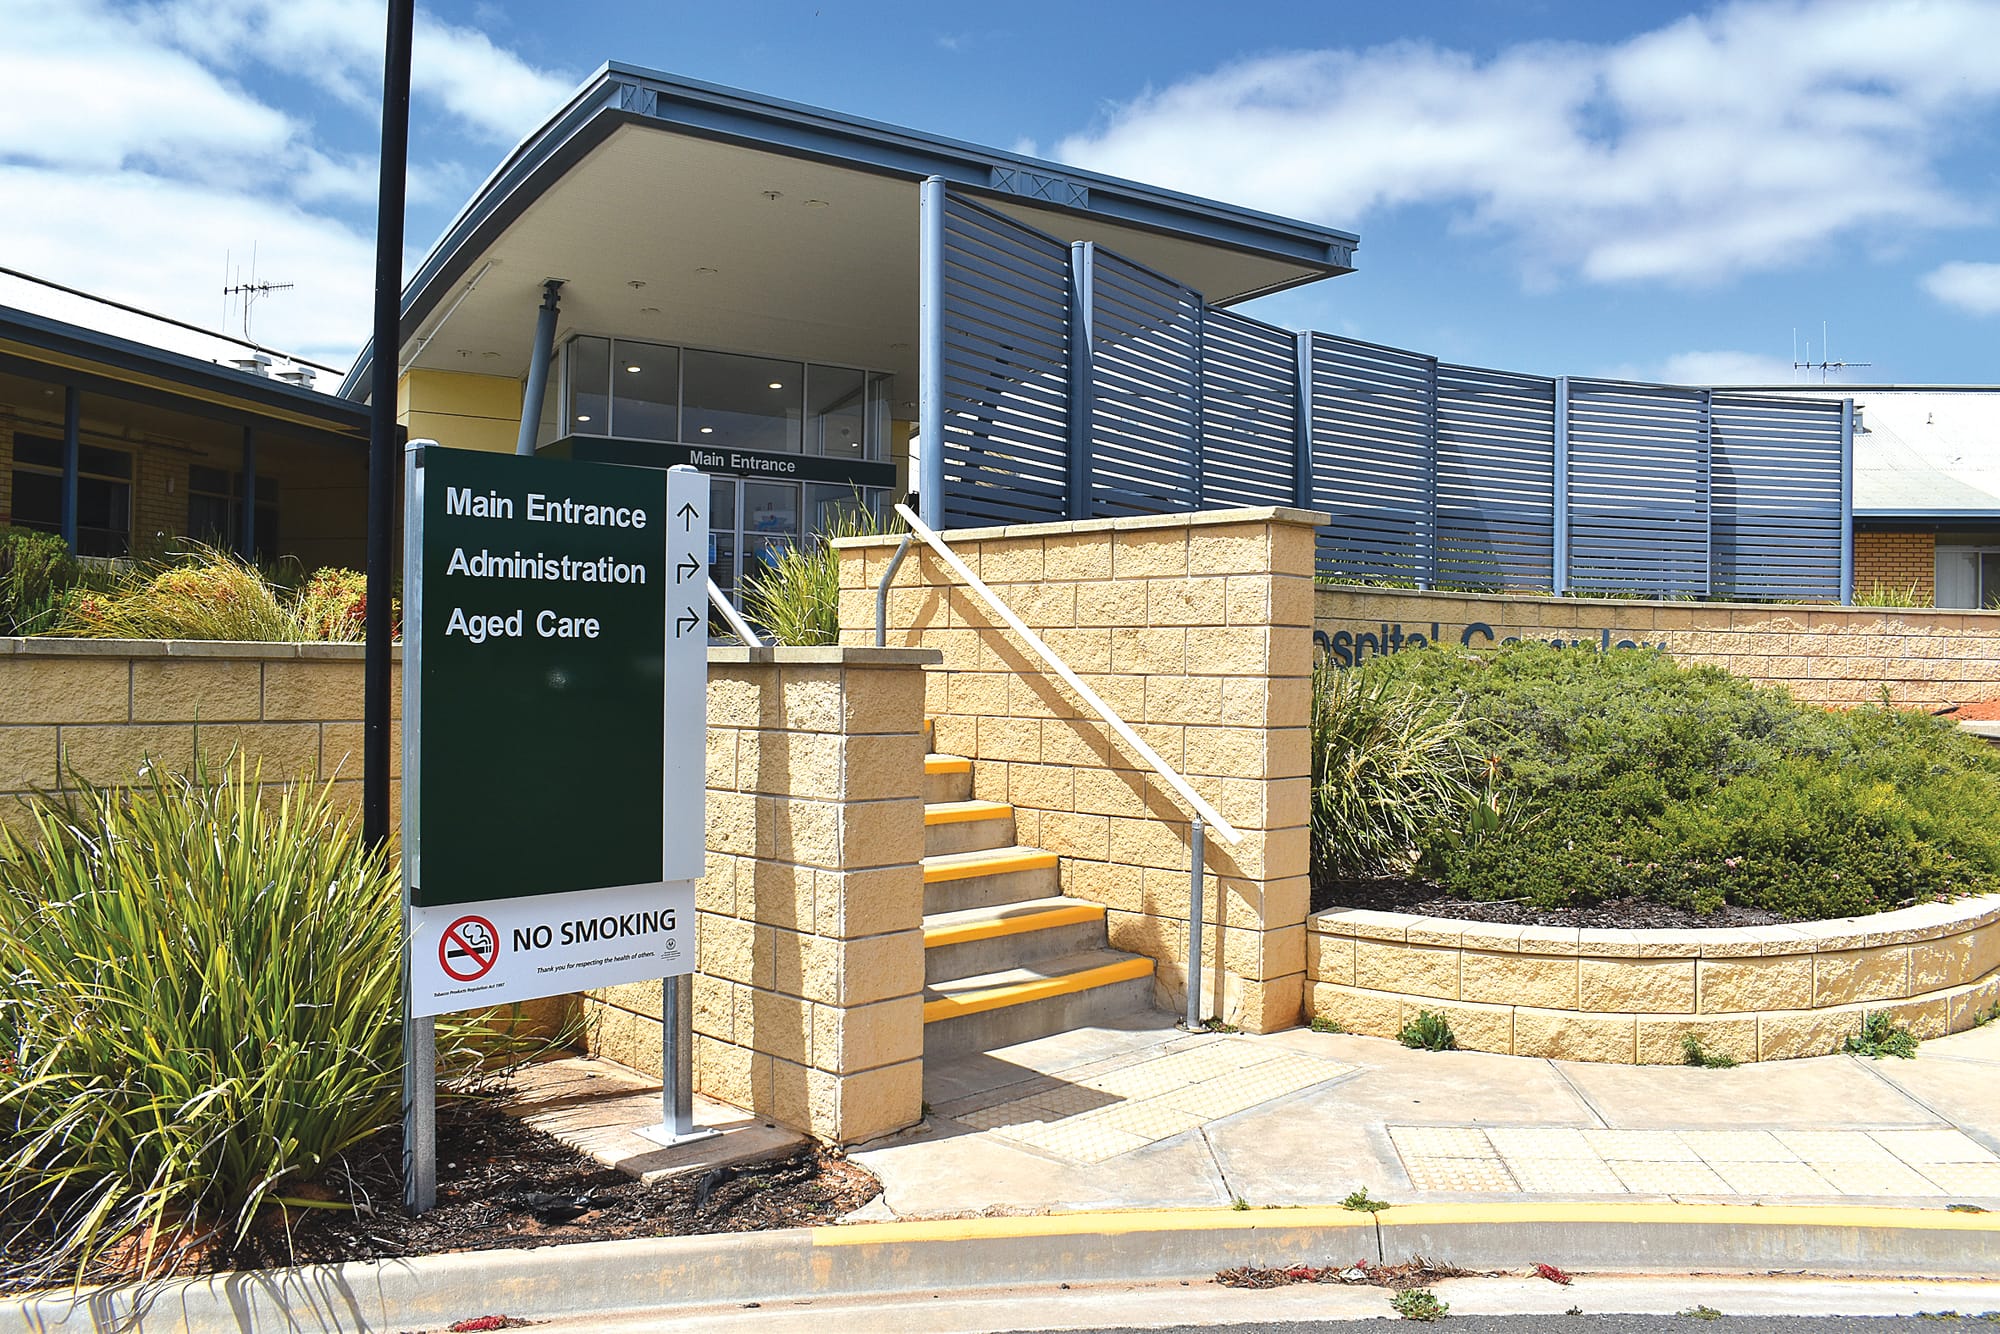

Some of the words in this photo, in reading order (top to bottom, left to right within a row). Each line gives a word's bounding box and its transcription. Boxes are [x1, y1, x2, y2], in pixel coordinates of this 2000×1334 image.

[690, 450, 724, 467] Main
[731, 453, 796, 473] Entrance
[446, 486, 513, 519] Main
[527, 493, 647, 529] Entrance
[447, 548, 646, 584] Administration
[446, 608, 523, 643] Aged
[536, 610, 600, 638] Care
[513, 925, 552, 952] NO
[561, 909, 676, 945] SMOKING
[537, 966, 554, 974] Thank
[555, 964, 566, 973] you
[576, 958, 604, 968] respecting
[604, 956, 614, 964] the
[614, 953, 631, 962] health
[631, 952, 639, 960] of
